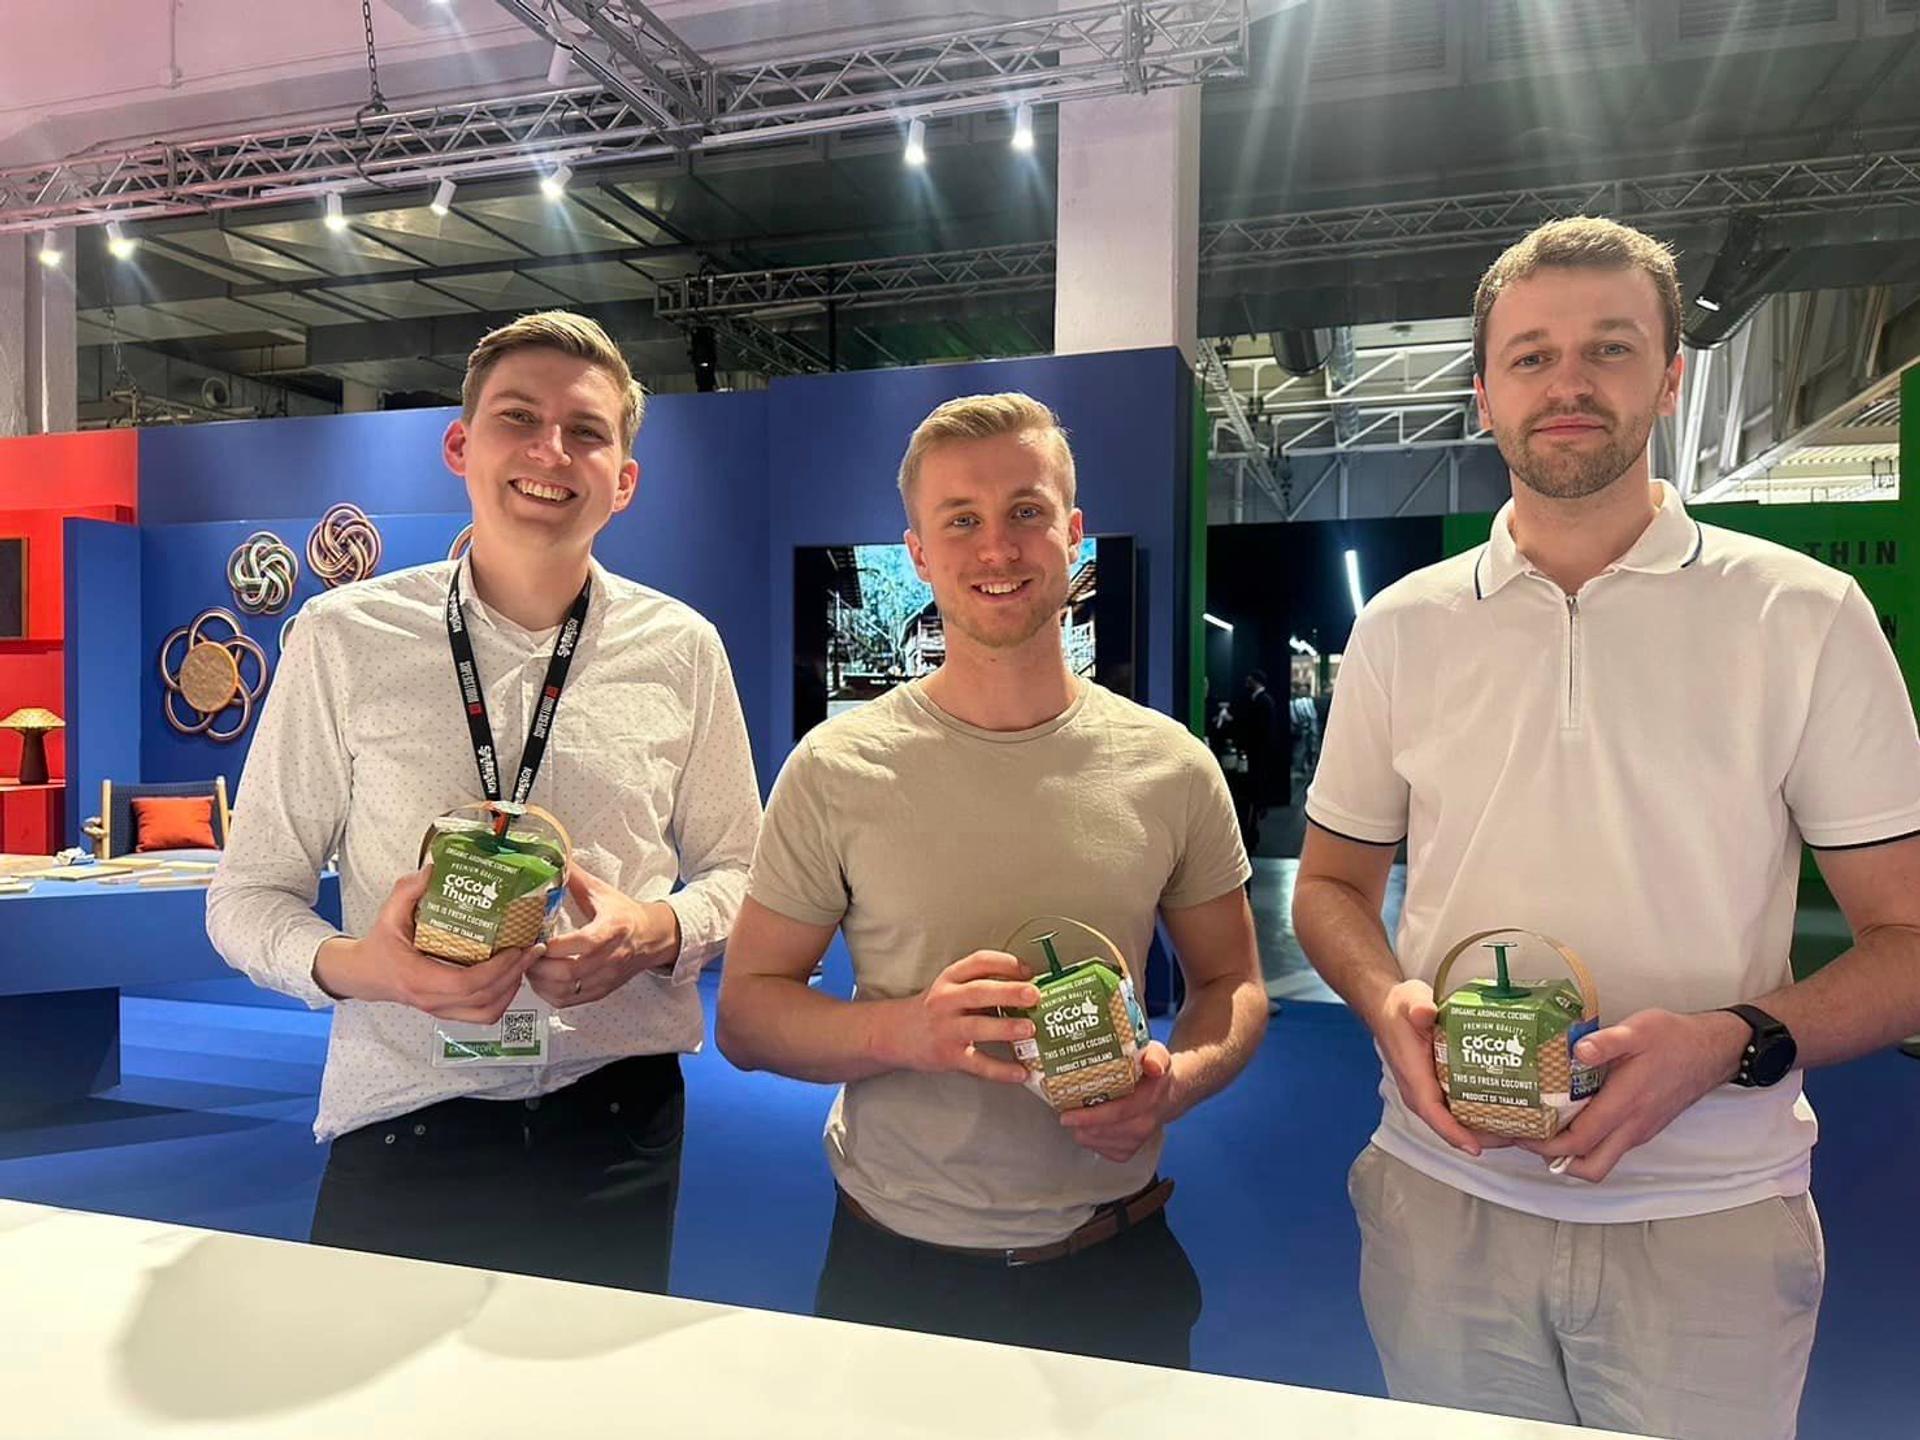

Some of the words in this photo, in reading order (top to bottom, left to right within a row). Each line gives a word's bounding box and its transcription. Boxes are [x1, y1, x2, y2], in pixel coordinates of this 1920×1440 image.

[450, 862, 479, 874] PREMIUM
[479, 870, 504, 882] QUALITY
[494, 862, 519, 875] COCONUT
[442, 884, 493, 910] Thumb
[427, 902, 441, 913] THIS
[441, 906, 448, 915] IS
[448, 908, 467, 922] FRESH
[466, 914, 494, 930] COCONUT
[429, 918, 452, 934] PRODUCT
[452, 926, 461, 936] OF
[460, 929, 486, 943] THAILAND
[1073, 975, 1098, 989] COCONUT
[1041, 995, 1068, 1010] PREMIUM
[1068, 989, 1093, 1002] QUALITY
[1450, 1007, 1476, 1017] ORGANIC
[1476, 1009, 1506, 1020] AROMATIC
[1507, 1012, 1536, 1022] COCONUT
[1045, 1014, 1099, 1038] Thumb
[1462, 1022, 1493, 1031] PREMIUM
[1495, 1024, 1524, 1035] QUALITY
[1044, 1050, 1058, 1061] THIS
[1059, 1047, 1066, 1056] IS
[1066, 1042, 1086, 1055] FRESH
[1086, 1035, 1114, 1050] COCONUT
[1056, 1060, 1079, 1074] PRODUCT
[1079, 1058, 1087, 1068] OF
[1087, 1051, 1113, 1066] THAILAND
[1461, 1049, 1523, 1068] Thumb
[1453, 1073, 1467, 1083] THIS
[1469, 1075, 1476, 1084] IS
[1477, 1077, 1499, 1087] FRESH
[1501, 1078, 1532, 1090] COCONUT
[1462, 1092, 1489, 1102] PRODUCT
[1489, 1094, 1498, 1103] OF
[1499, 1095, 1529, 1106] THAILAND
